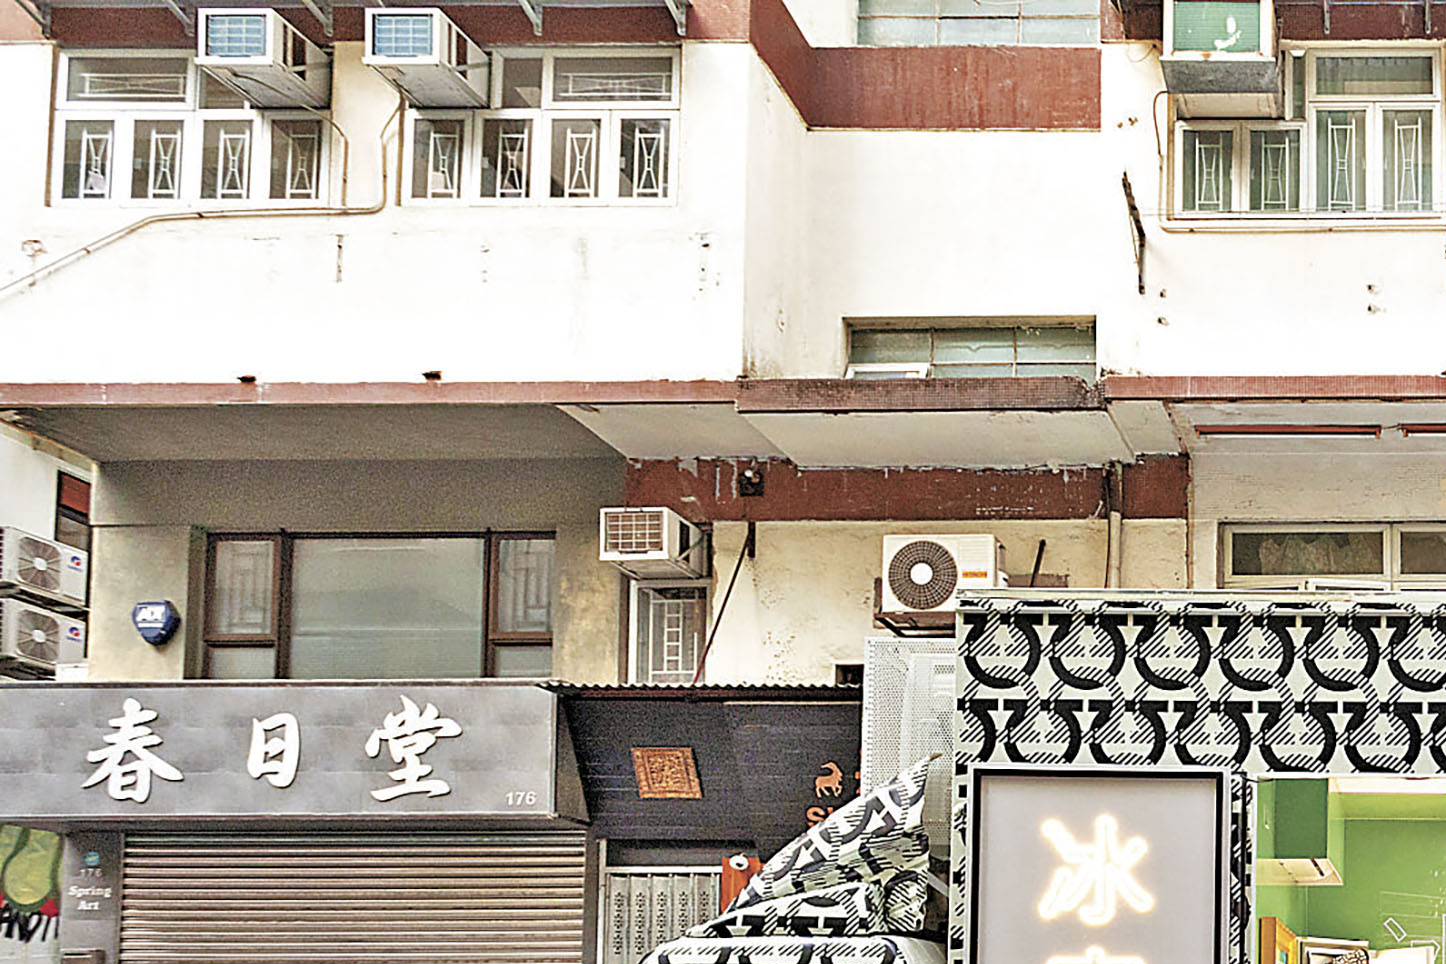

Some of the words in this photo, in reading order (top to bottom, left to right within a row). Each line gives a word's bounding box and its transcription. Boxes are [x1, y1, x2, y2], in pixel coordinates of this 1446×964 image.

[81, 695, 462, 802] 春日堂
[505, 791, 536, 806] 176
[68, 885, 112, 898] Spring
[77, 901, 100, 911] Art
